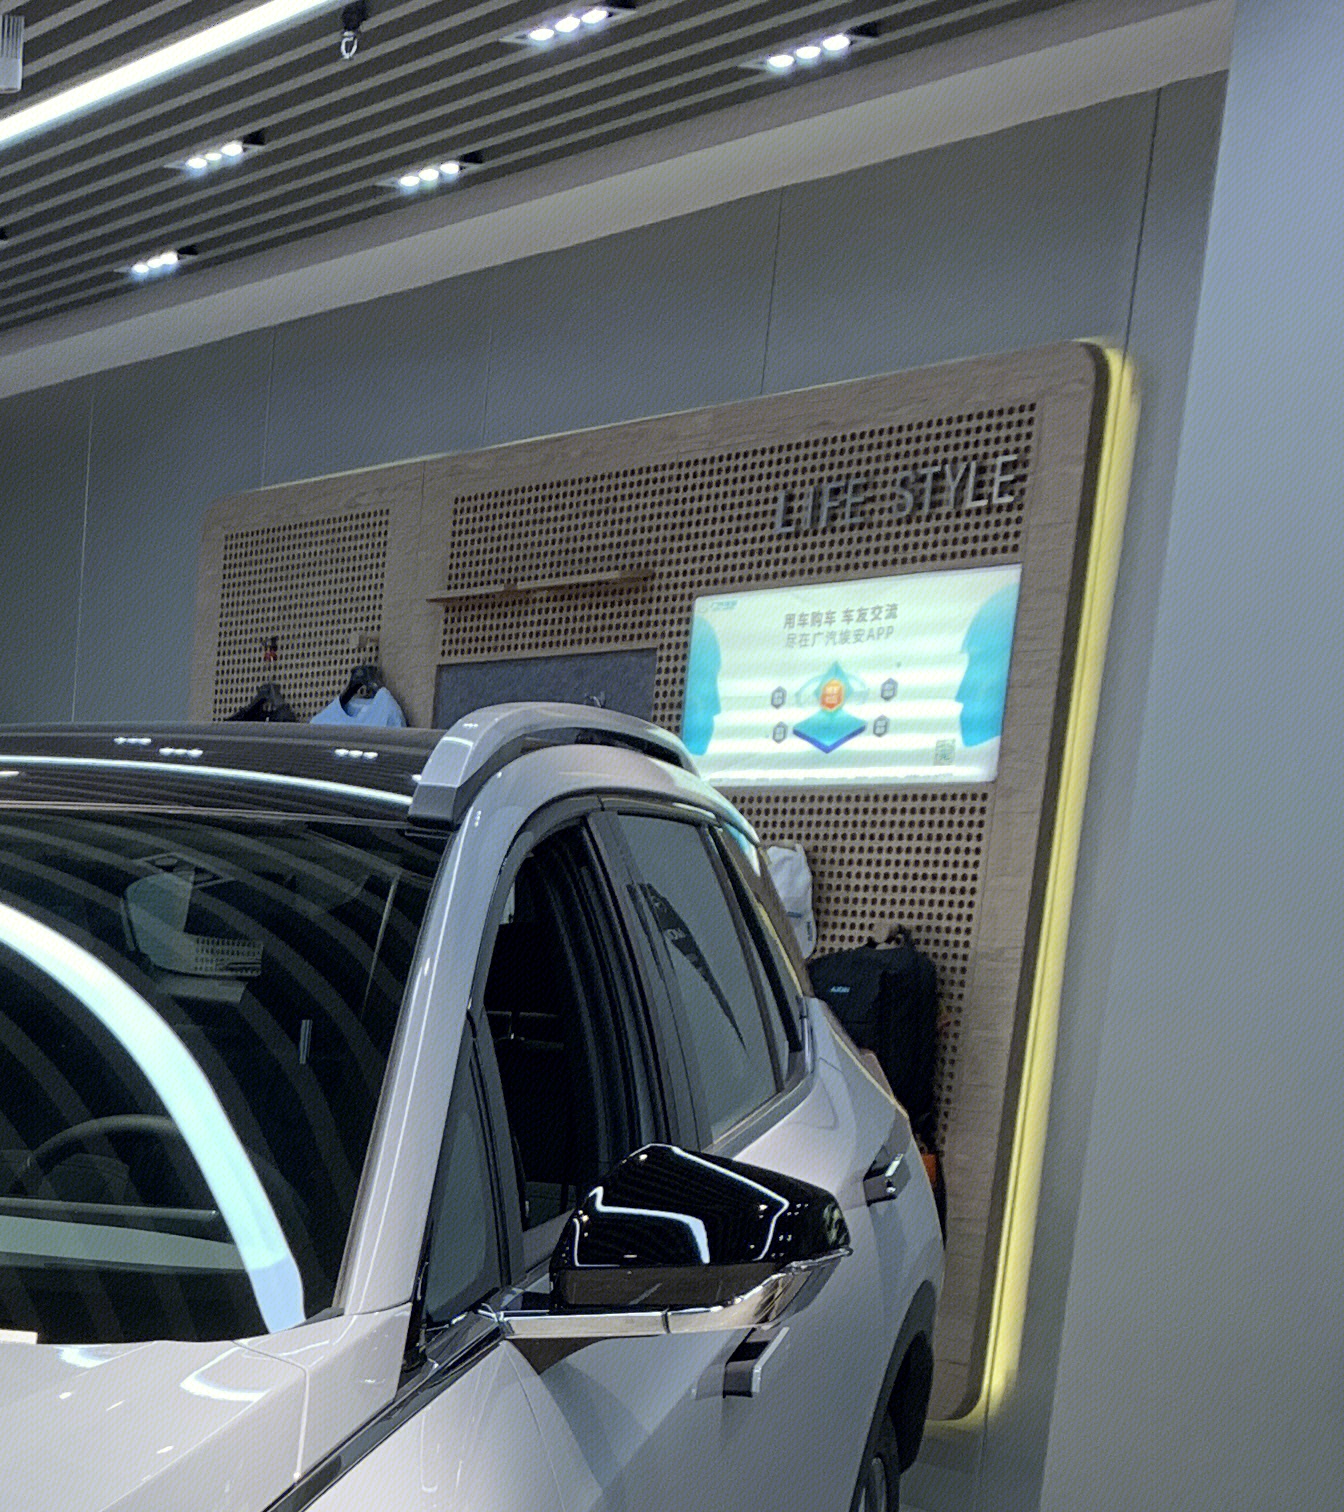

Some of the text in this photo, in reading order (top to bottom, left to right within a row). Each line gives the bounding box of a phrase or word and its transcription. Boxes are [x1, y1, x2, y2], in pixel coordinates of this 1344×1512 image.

[775, 454, 1019, 534] LIFE STYLE
[784, 603, 899, 629] 用车购车 车友交流
[785, 625, 895, 648] 尽在广汽埃安APP
